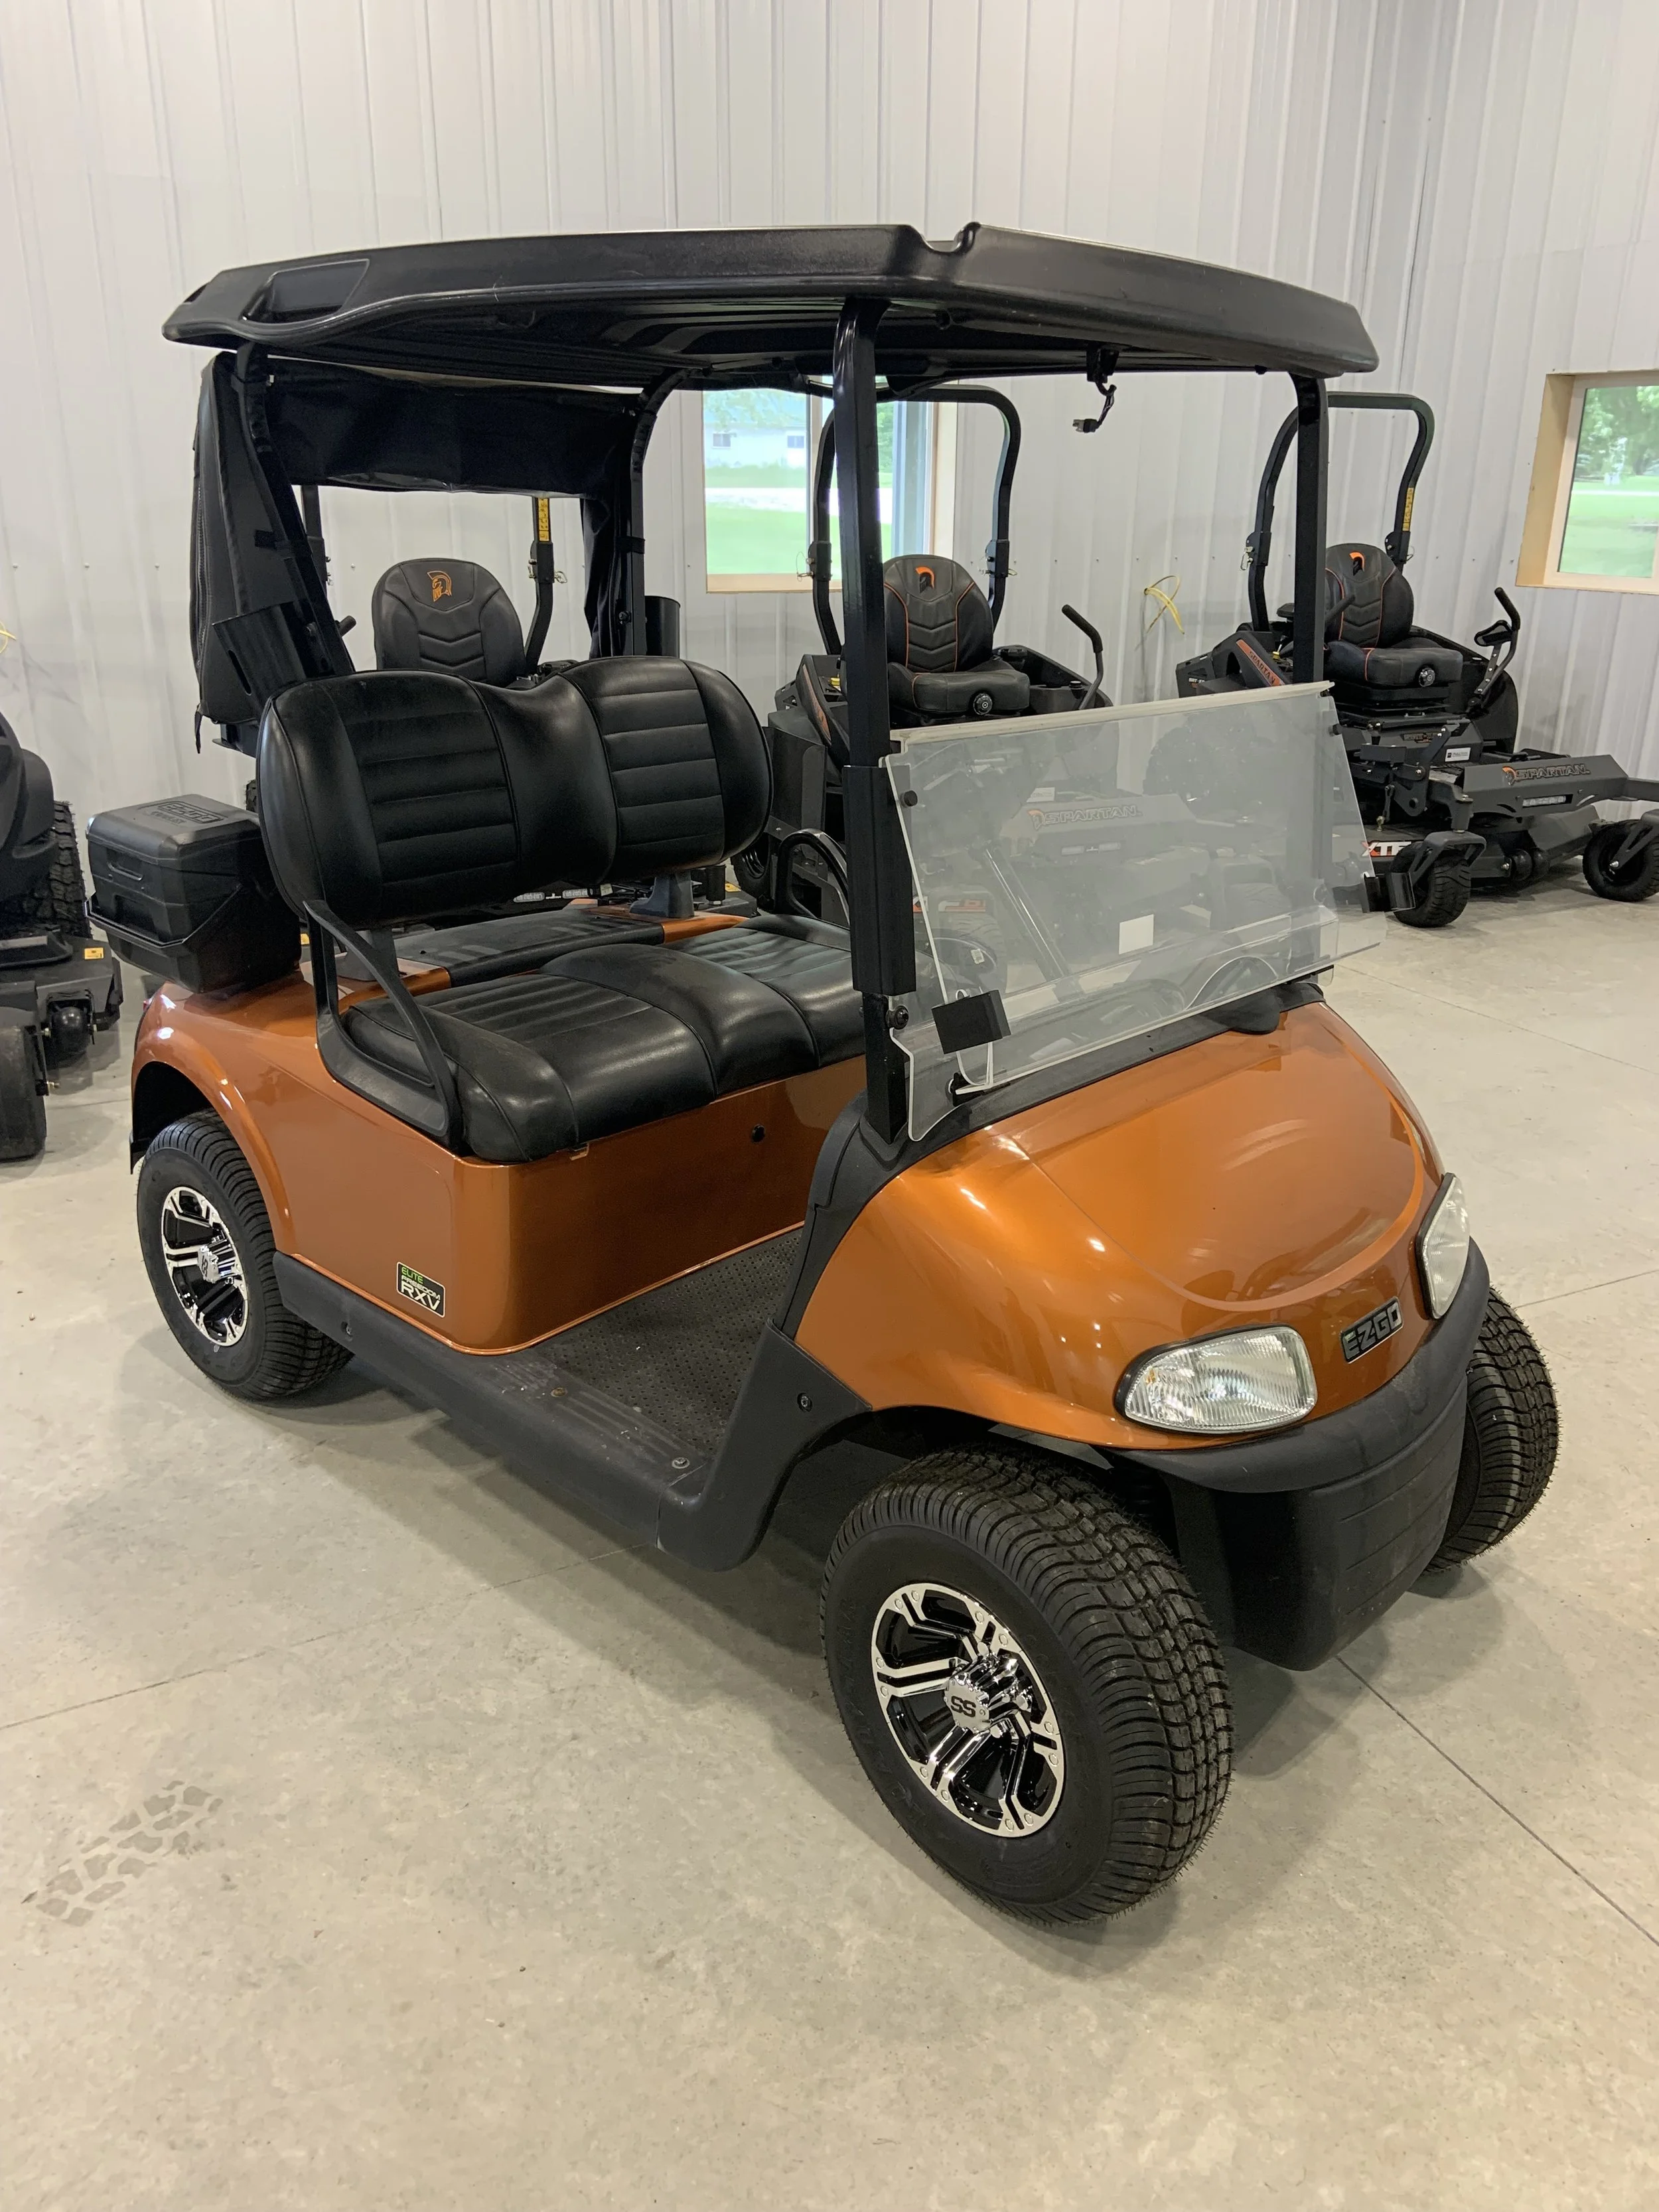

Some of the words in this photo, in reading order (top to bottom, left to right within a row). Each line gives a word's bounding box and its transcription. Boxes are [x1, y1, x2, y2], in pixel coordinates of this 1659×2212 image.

[1516, 764, 1586, 780] SPARTAN
[1045, 805, 1136, 824] SPARTAN
[401, 1274, 441, 1300] FREEDOM
[401, 1281, 440, 1310] RXV
[951, 1696, 975, 1718] SS
